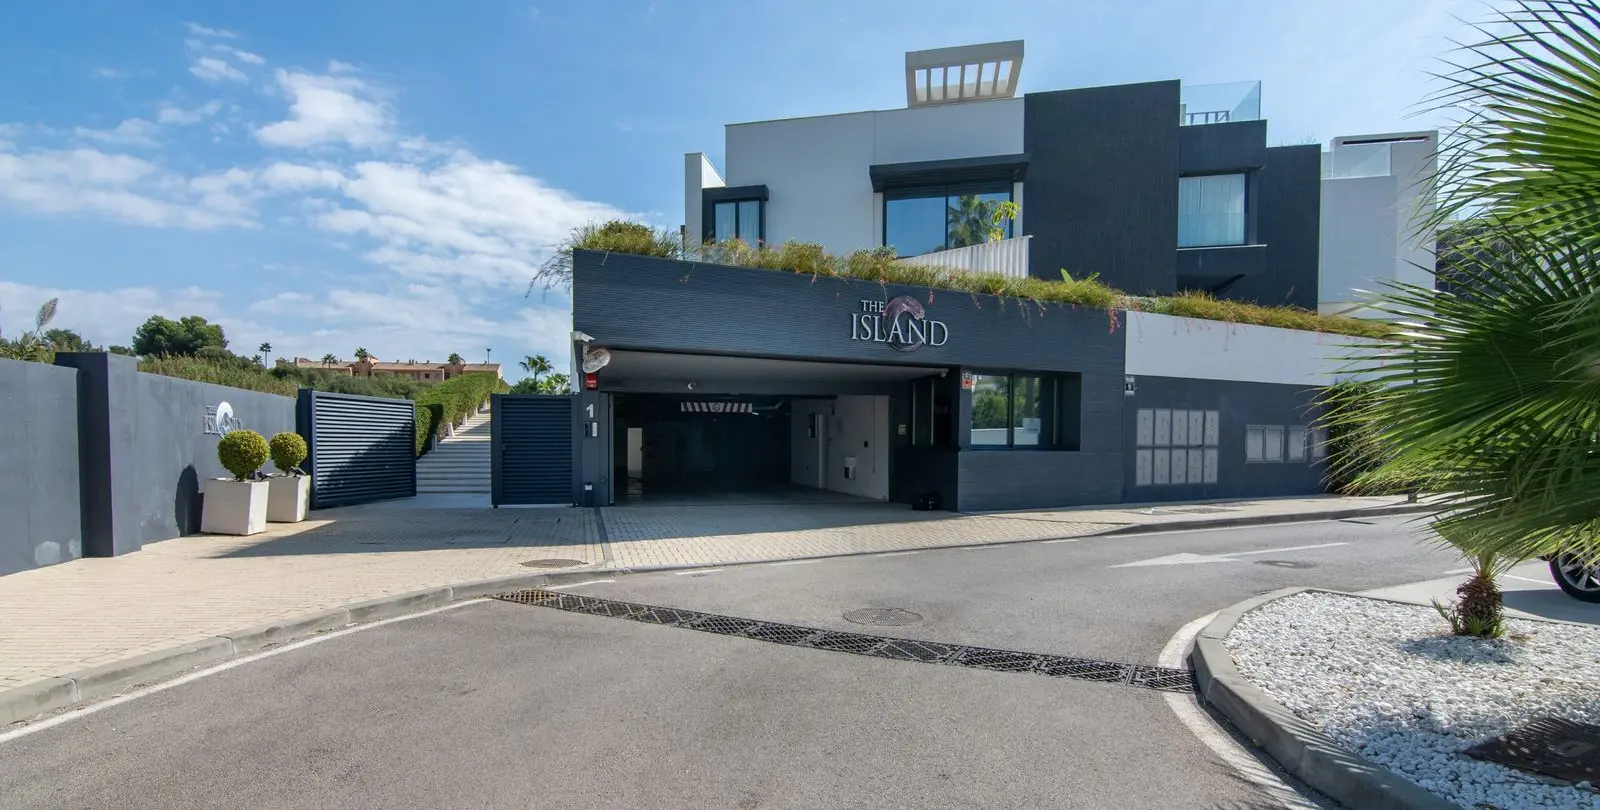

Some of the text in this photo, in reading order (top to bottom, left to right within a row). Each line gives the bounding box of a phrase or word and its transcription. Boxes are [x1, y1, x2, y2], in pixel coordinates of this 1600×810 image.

[861, 299, 884, 313] THE
[851, 313, 949, 346] ISLAND
[586, 403, 594, 418] 1
